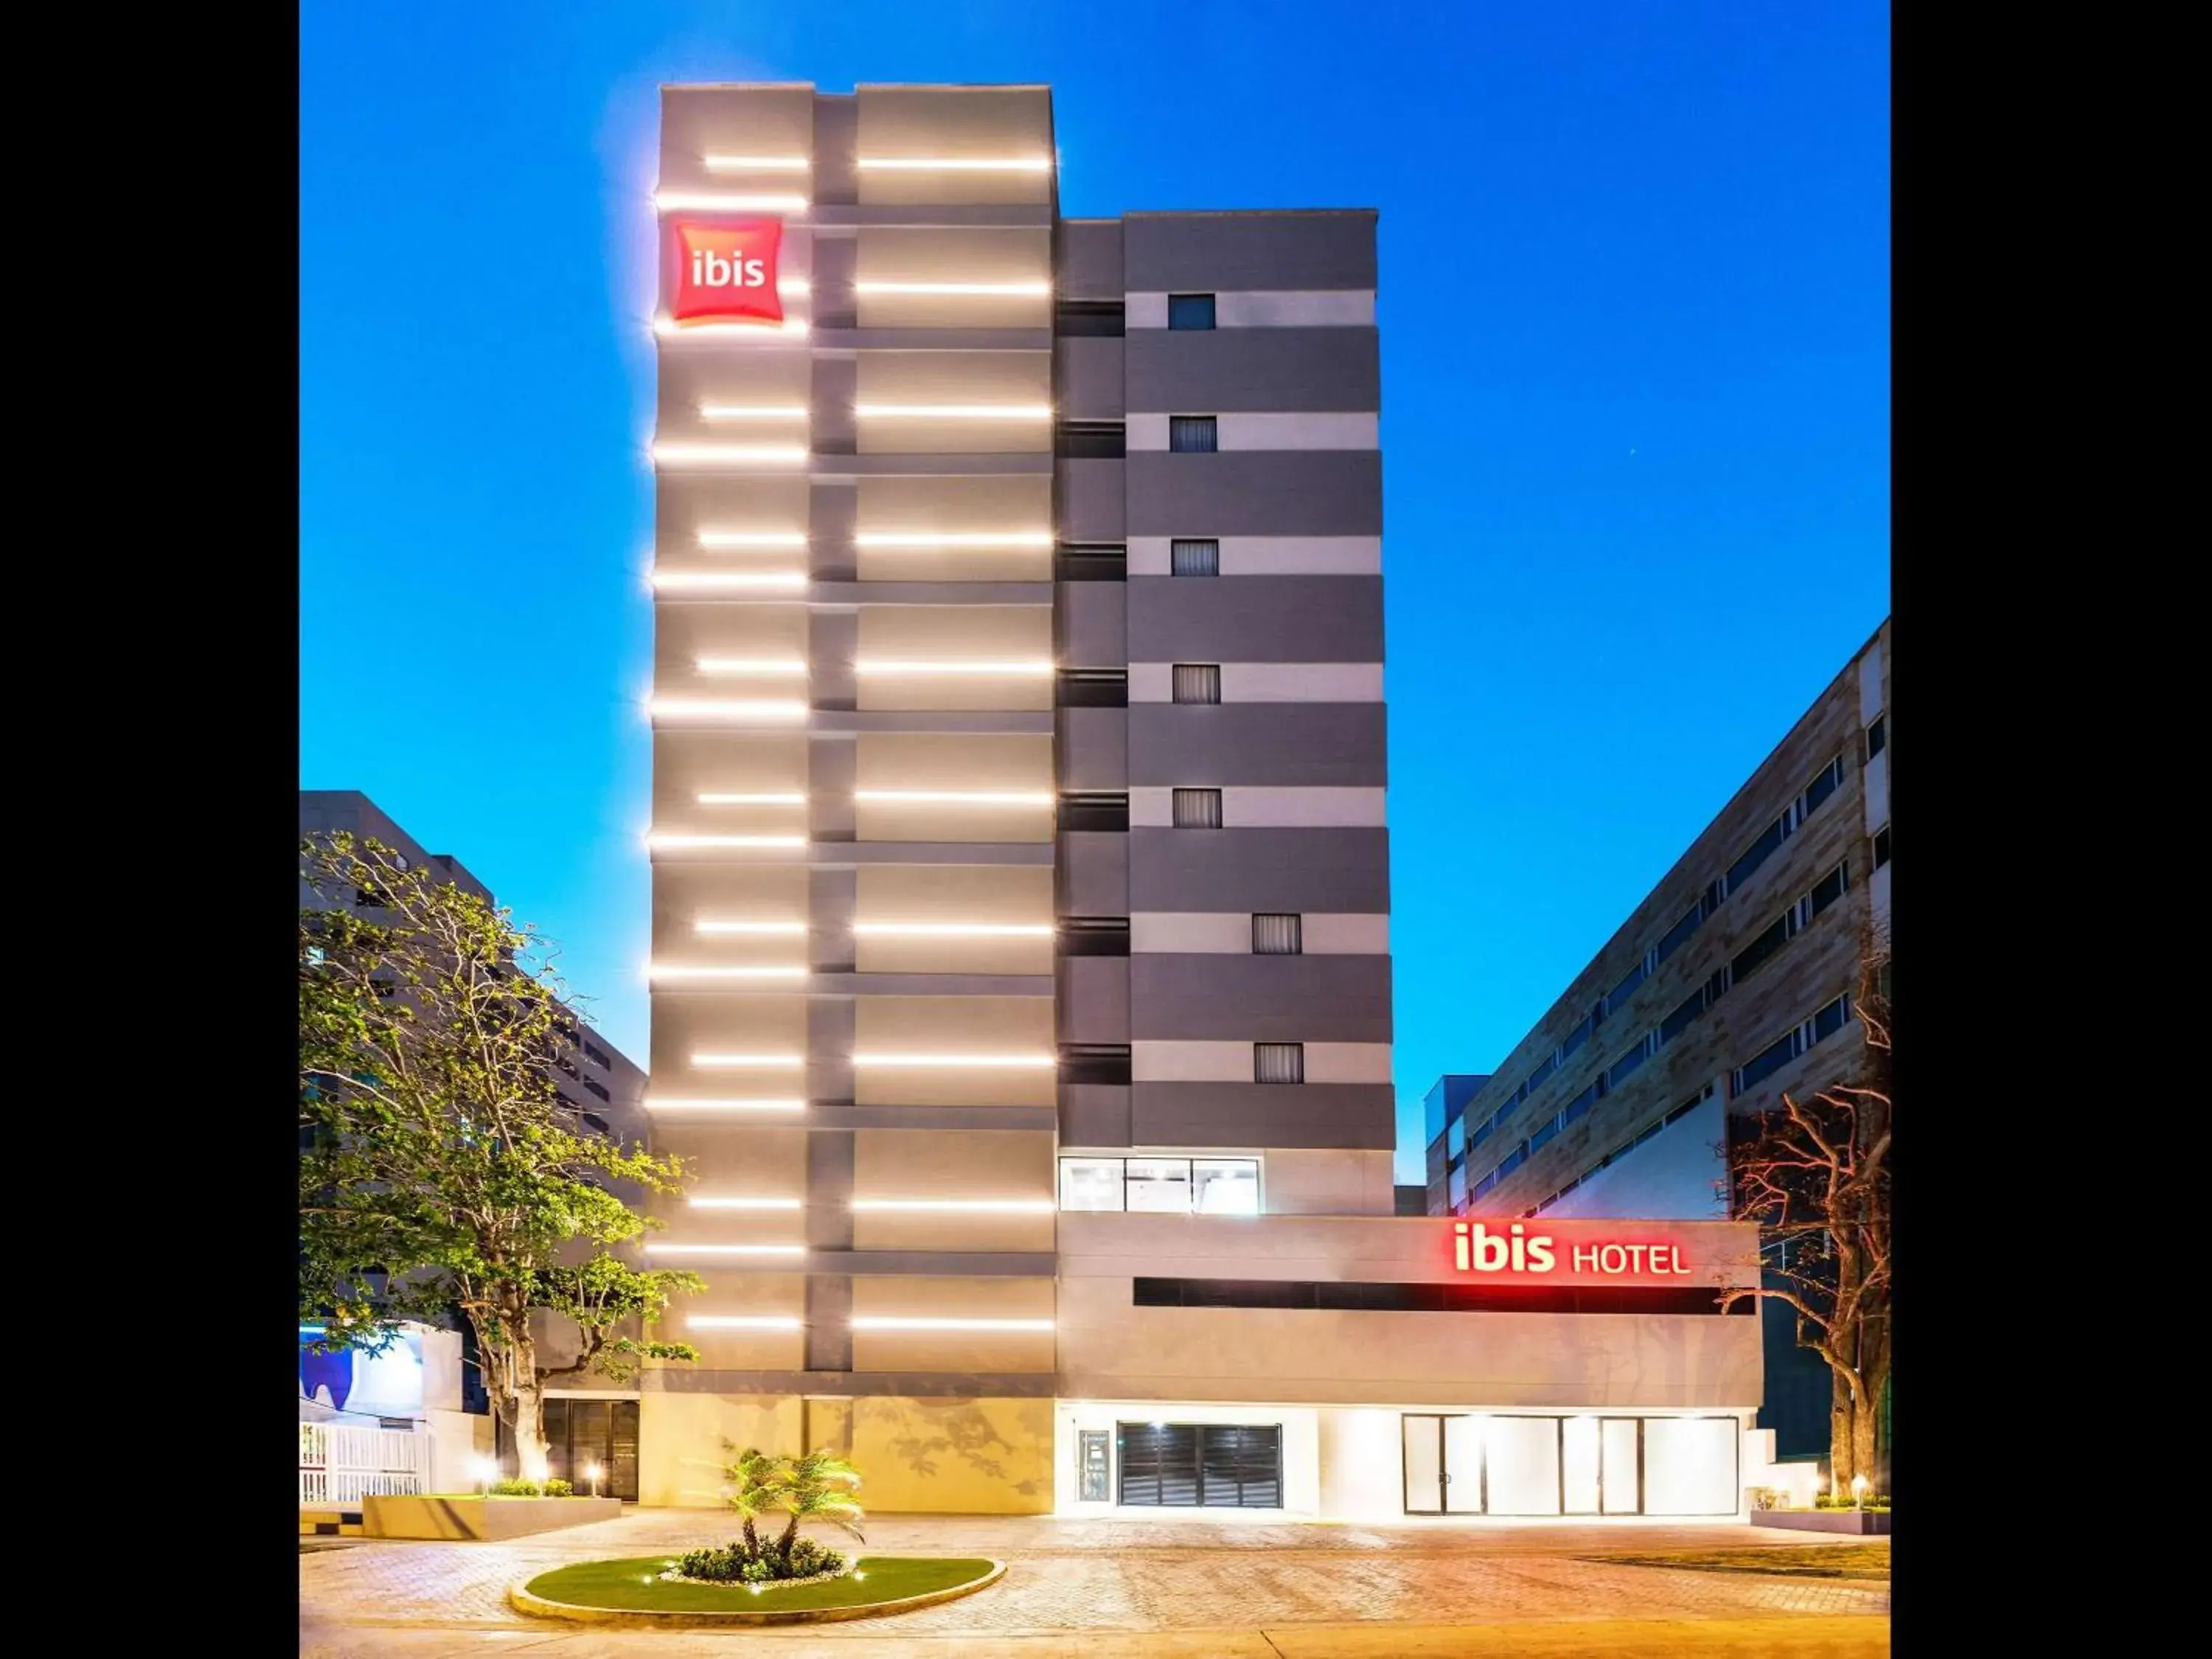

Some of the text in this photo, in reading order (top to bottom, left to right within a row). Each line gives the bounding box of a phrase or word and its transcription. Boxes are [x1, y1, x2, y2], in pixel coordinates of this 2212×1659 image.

[692, 251, 765, 286] ibis
[1455, 1223, 1691, 1274] ibis HOTEL
